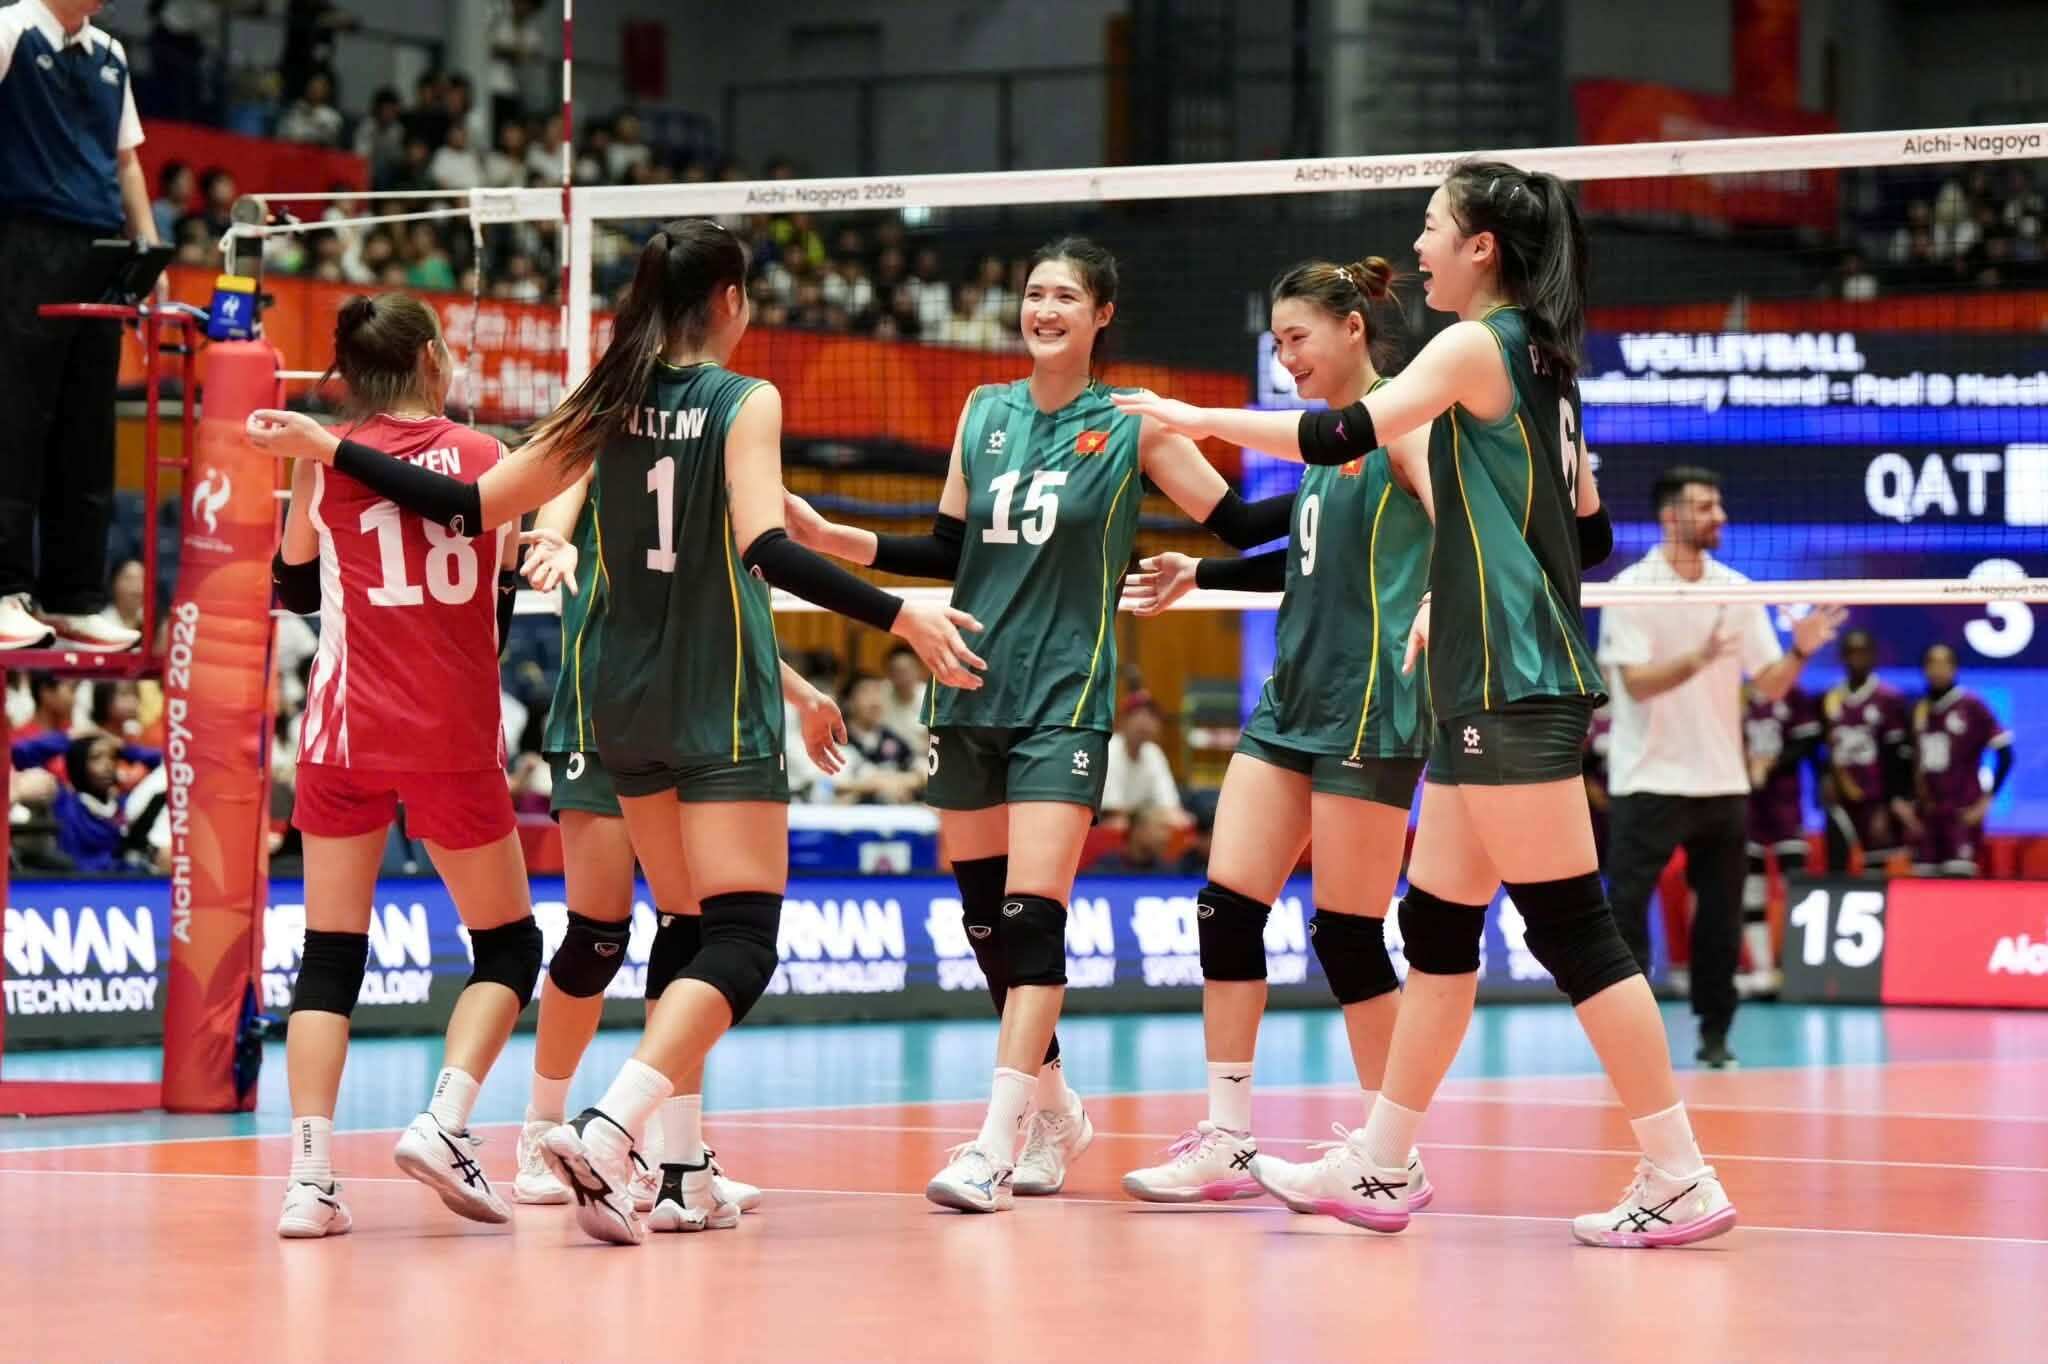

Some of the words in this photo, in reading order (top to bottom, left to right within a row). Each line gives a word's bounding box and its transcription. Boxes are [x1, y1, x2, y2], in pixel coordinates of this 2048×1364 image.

[1294, 162, 1417, 183] Aichi-Nagoya
[1423, 159, 1458, 176] 202
[1903, 134, 2041, 155] Aichi-Nagoya
[745, 187, 860, 208] Aichi-Nagoya
[863, 183, 906, 201] 2026
[1619, 332, 1866, 372] VOLLEYBALL
[647, 456, 677, 572] 1
[982, 470, 1069, 545] 15
[1865, 452, 2002, 523] QAT
[360, 500, 479, 607] 18
[1300, 494, 1320, 576] 9
[168, 601, 200, 691] 2026
[1963, 558, 2034, 659] 3
[168, 697, 195, 944] Aichi-Nagoya
[1790, 889, 1885, 968] 15
[3, 976, 158, 1014] TECHNOLOGY
